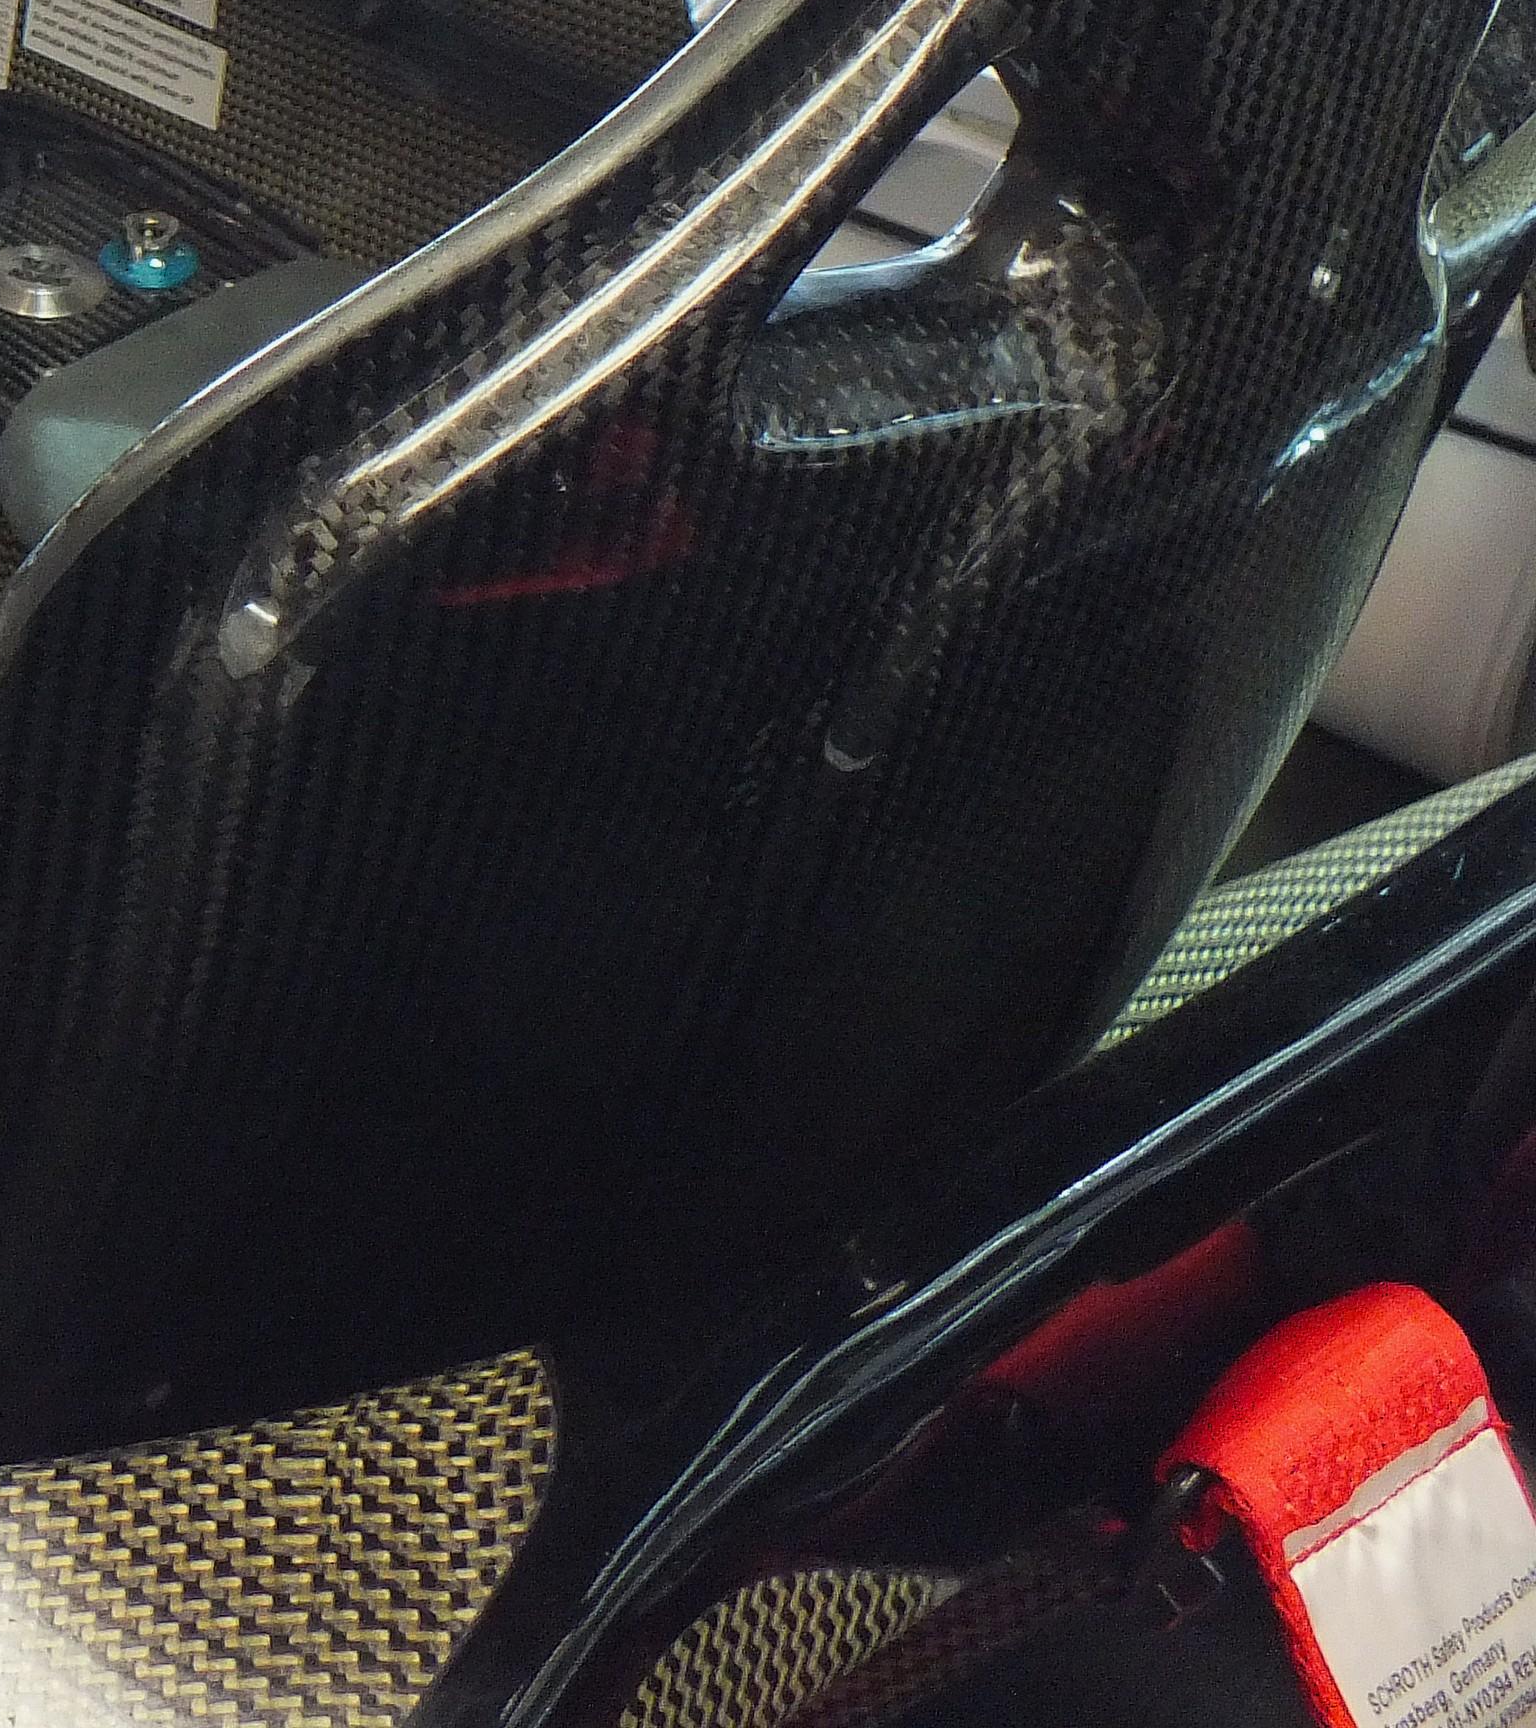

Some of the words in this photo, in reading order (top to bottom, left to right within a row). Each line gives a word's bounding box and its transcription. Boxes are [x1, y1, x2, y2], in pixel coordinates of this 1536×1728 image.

[1367, 1652, 1435, 1716] SCHROTH
[1431, 1629, 1466, 1669] Safety
[1461, 1590, 1513, 1641] Products
[1449, 1638, 1508, 1694] Germany
